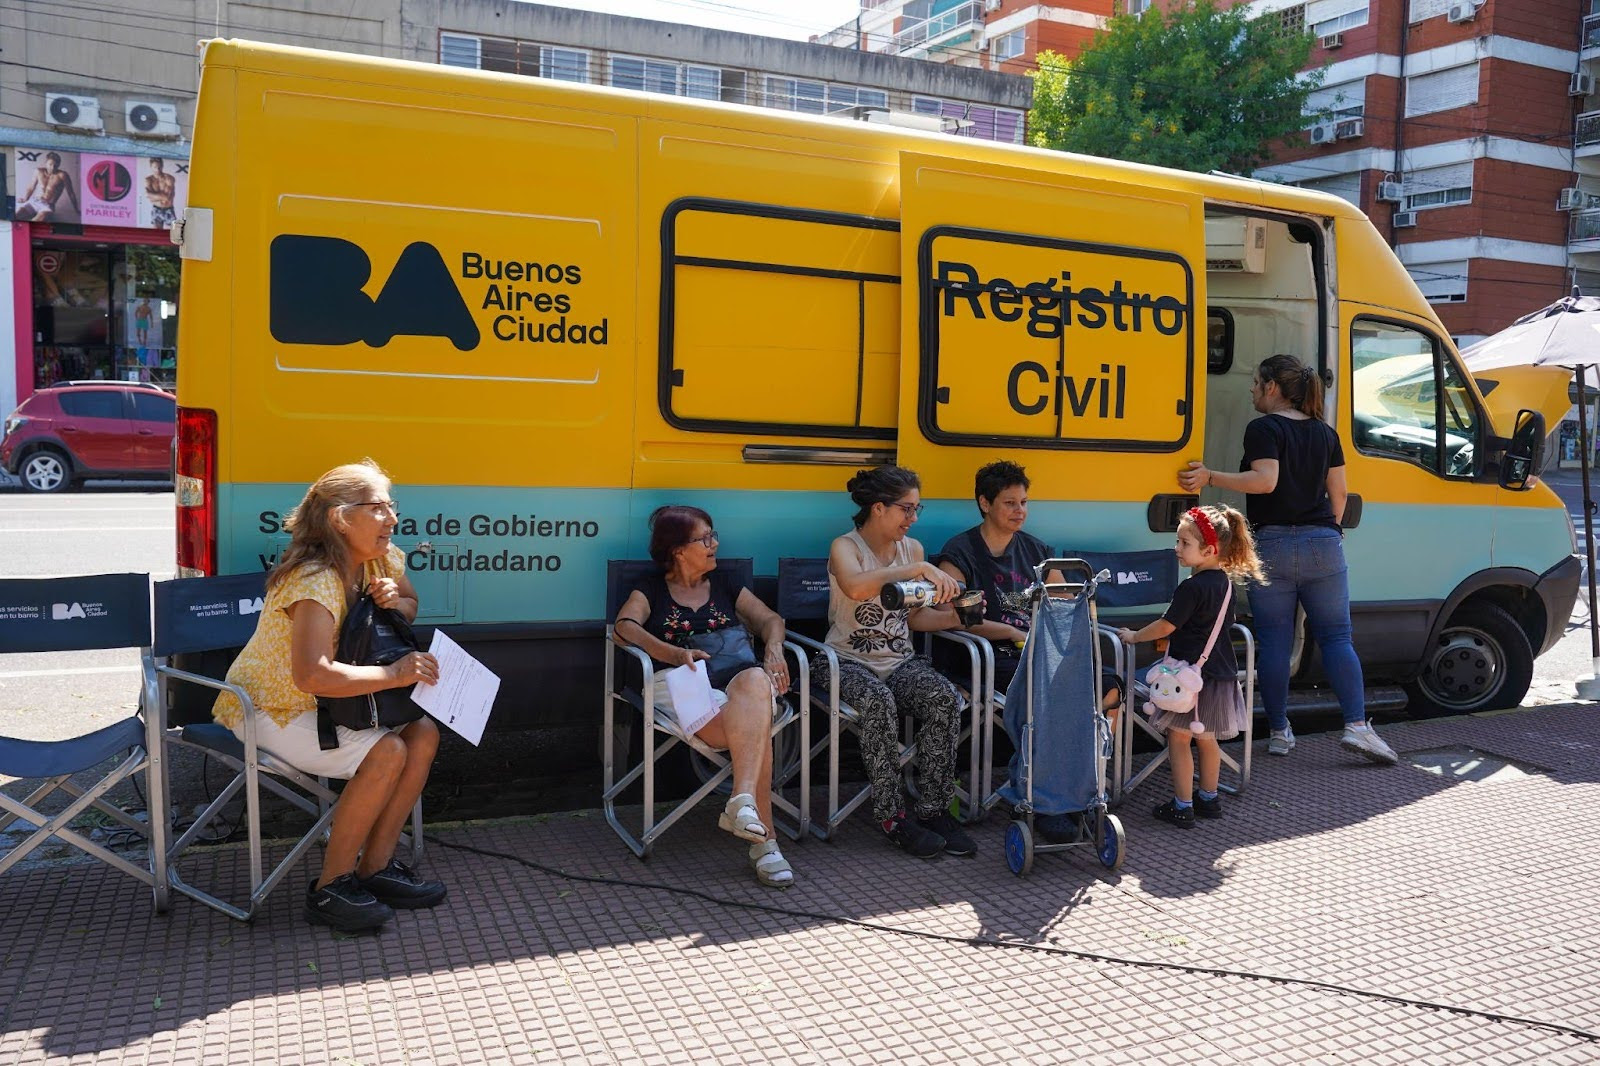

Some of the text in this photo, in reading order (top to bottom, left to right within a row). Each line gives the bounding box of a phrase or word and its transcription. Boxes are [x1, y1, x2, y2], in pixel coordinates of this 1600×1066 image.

[17, 151, 42, 162] XY
[175, 164, 189, 174] X
[85, 208, 131, 218] MARILEY
[462, 252, 582, 285] Buenos
[270, 233, 481, 351] BA
[482, 284, 571, 314] Aires
[938, 261, 1183, 339] Registro
[493, 314, 608, 345] Ciudad
[1007, 360, 1126, 419] Civil
[425, 513, 461, 536] de
[469, 514, 599, 538] Gobierno
[406, 550, 562, 572] Ciudadano
[1117, 571, 1138, 585] BA
[52, 602, 87, 620] BA
[203, 602, 228, 610] servicios
[239, 597, 265, 615] BA
